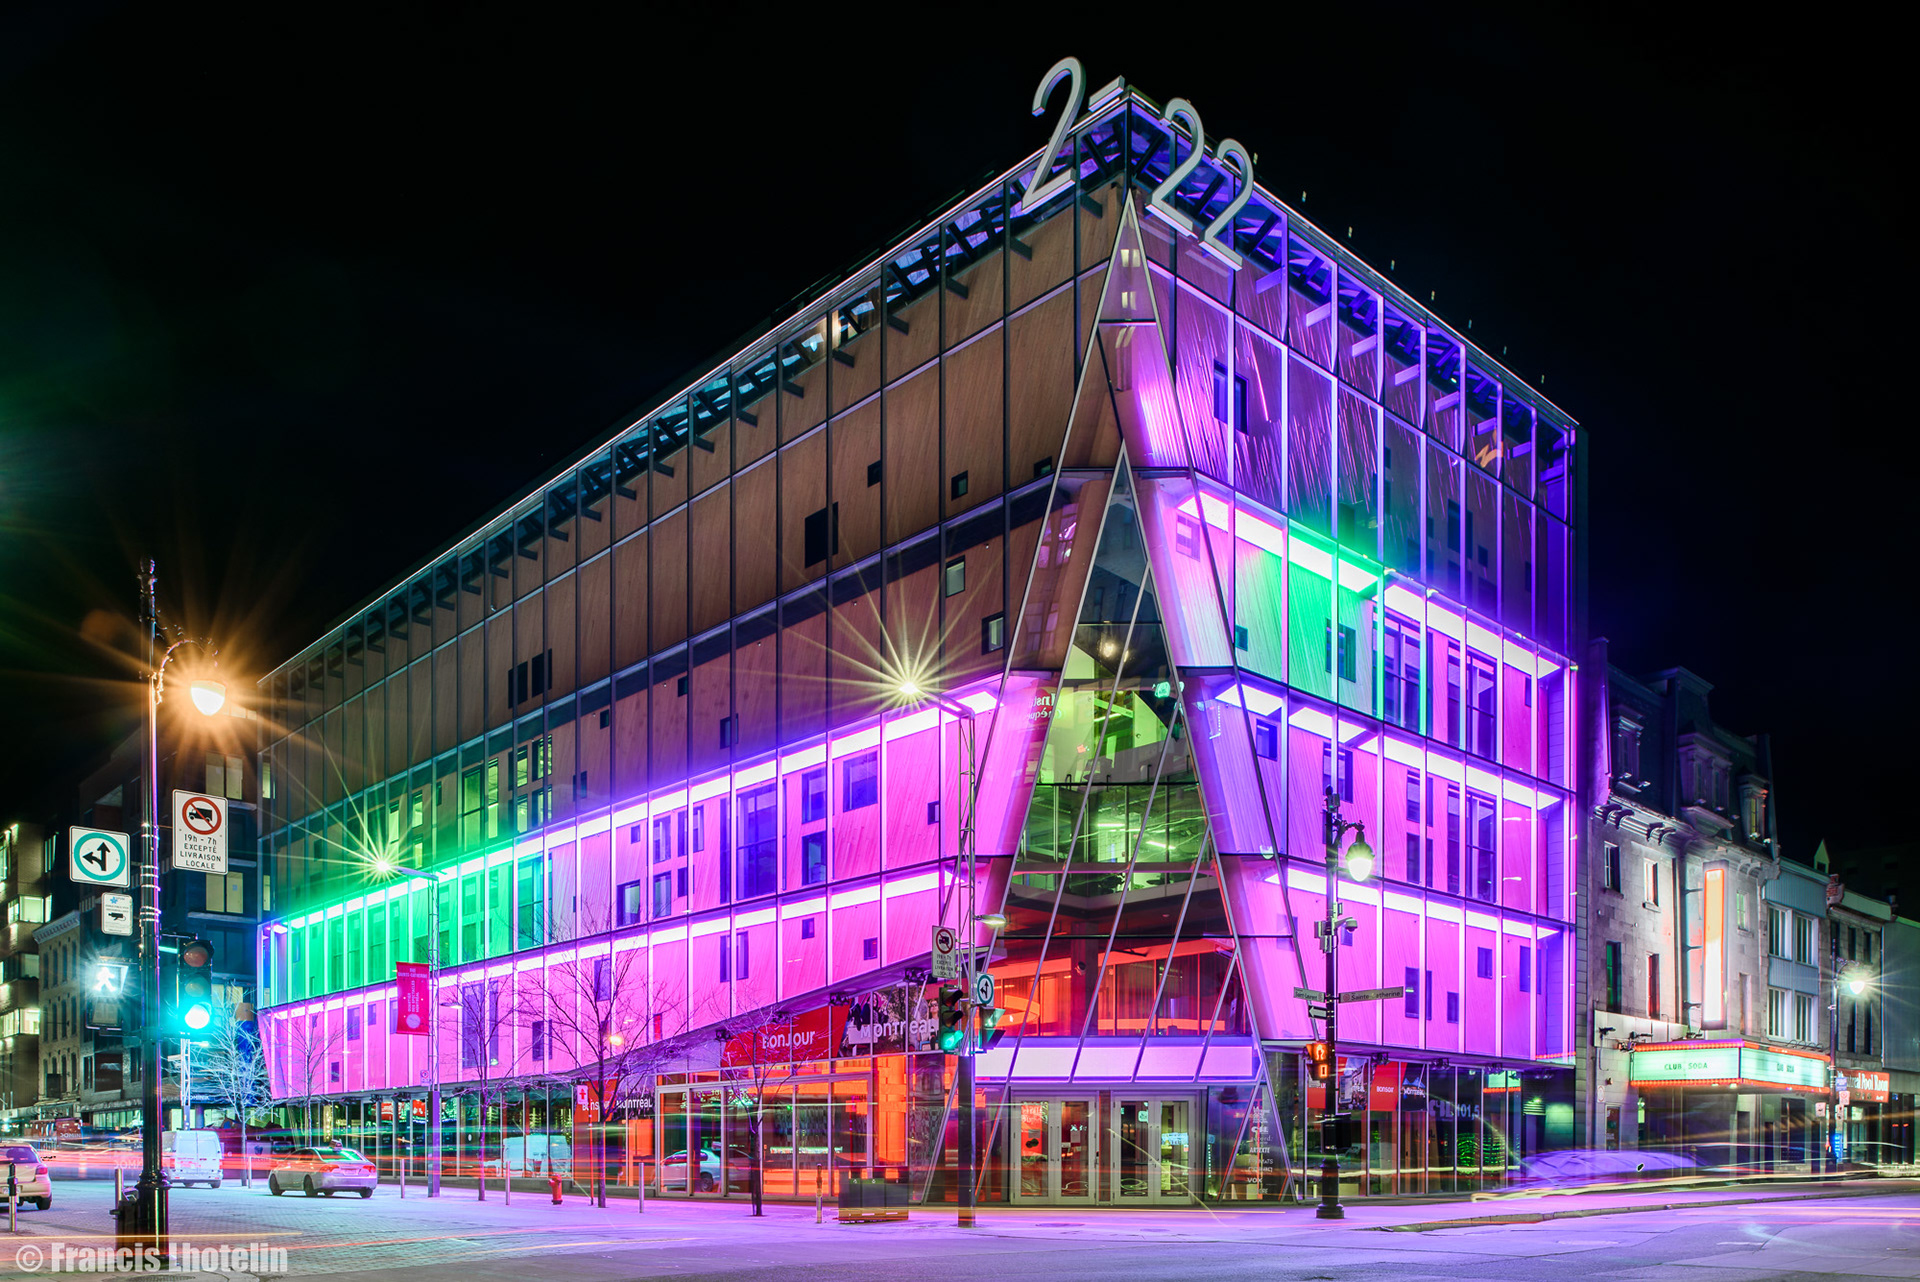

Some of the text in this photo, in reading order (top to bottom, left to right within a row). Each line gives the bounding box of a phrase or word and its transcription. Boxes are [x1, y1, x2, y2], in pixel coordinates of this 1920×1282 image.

[184, 833, 198, 842] 19h
[207, 836, 217, 845] 7h
[184, 842, 217, 853] EXCEPTÉ
[180, 850, 221, 862] LIVRAISON
[185, 859, 216, 869] LOCALE
[1664, 1062, 1708, 1071] CLUB SODA
